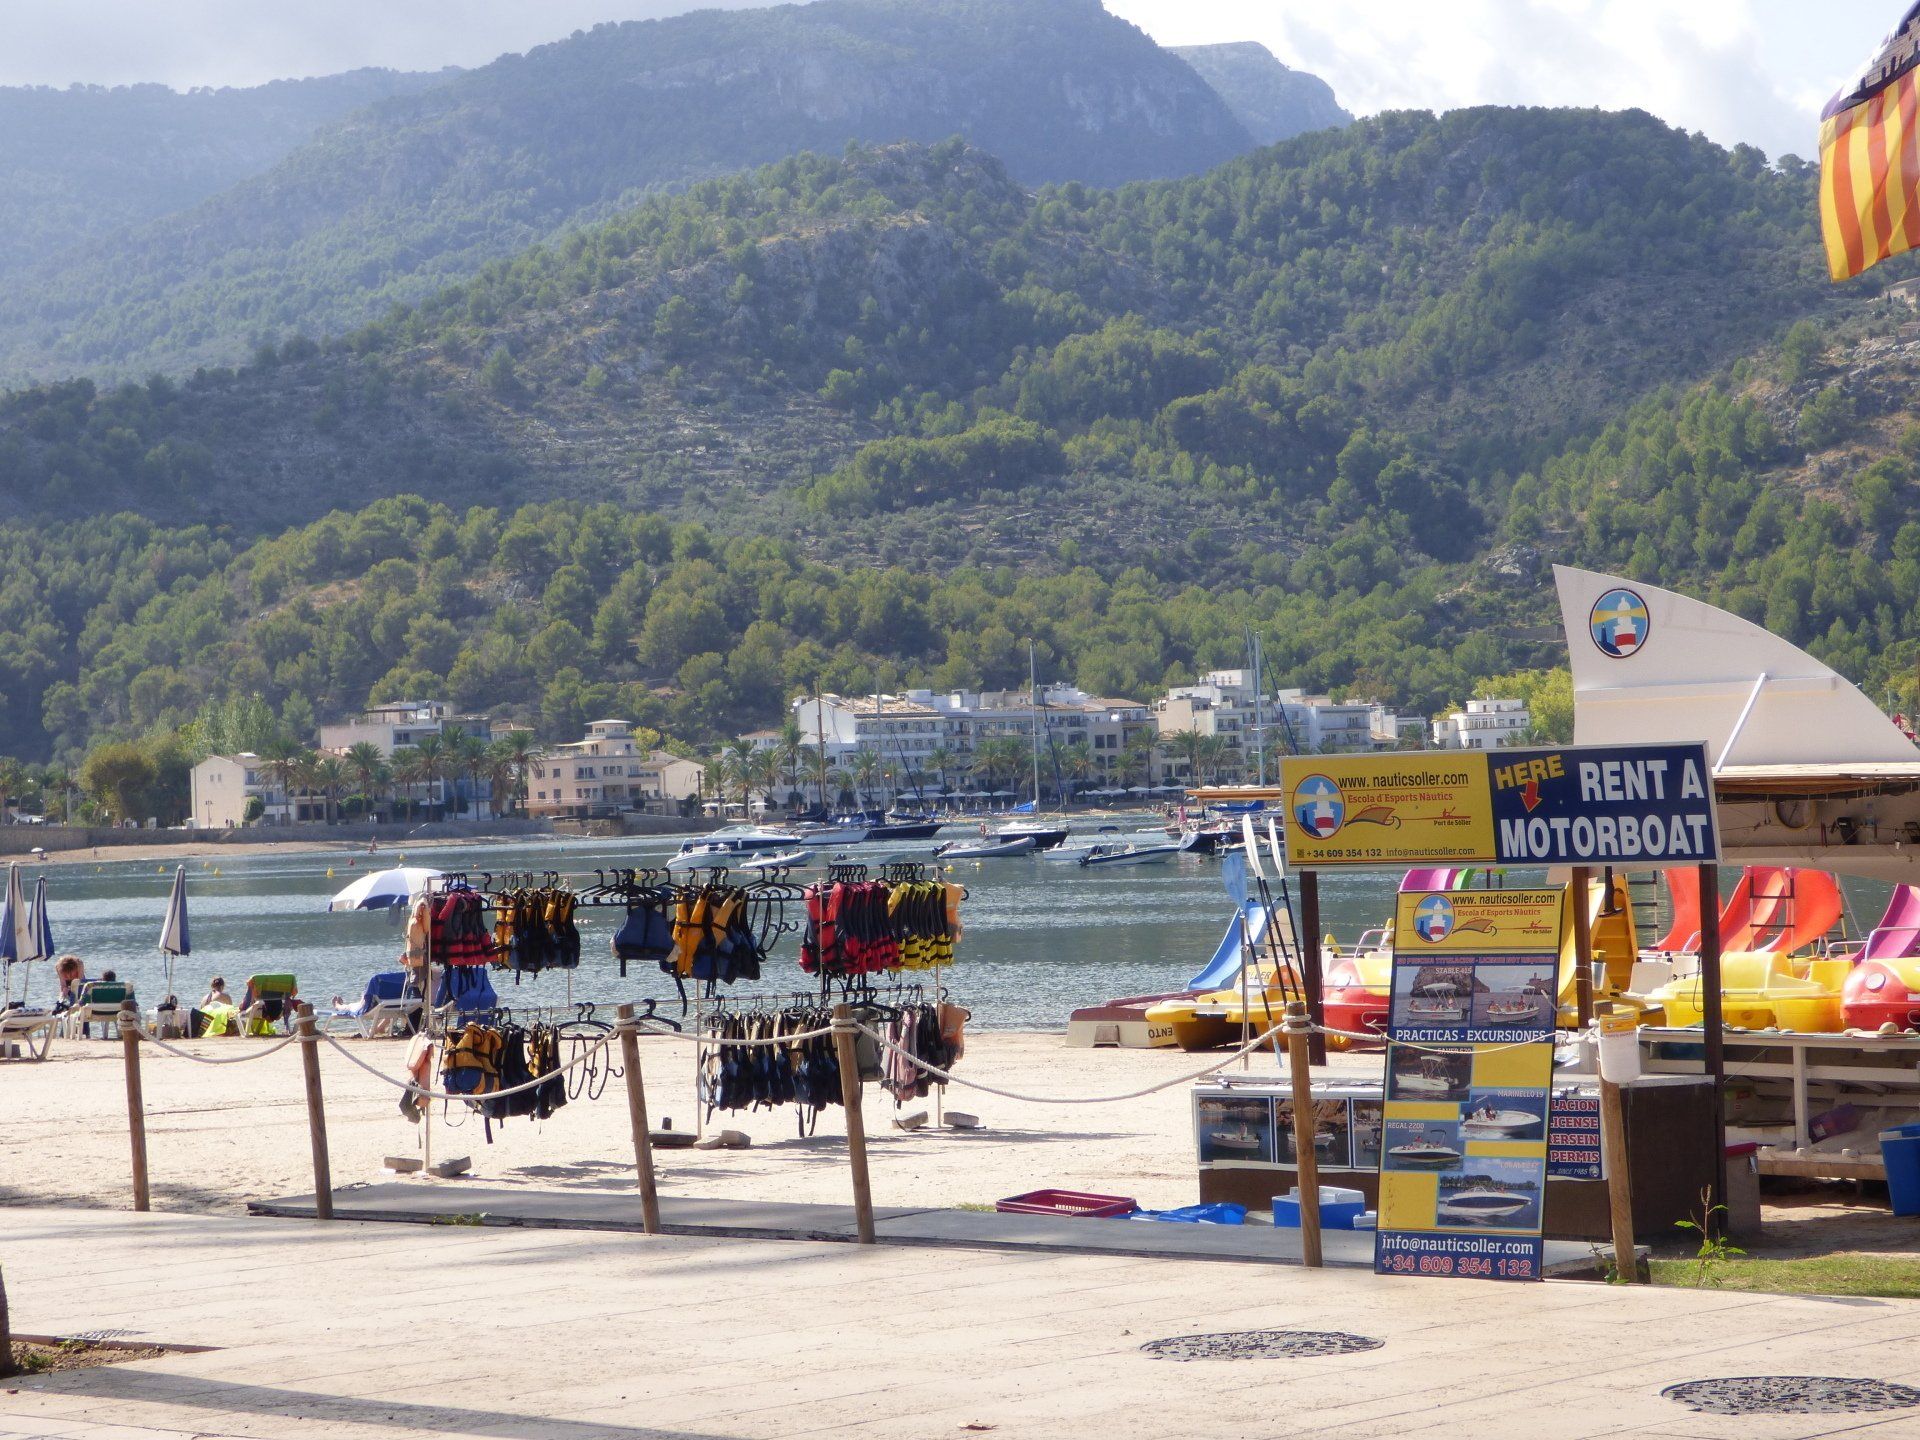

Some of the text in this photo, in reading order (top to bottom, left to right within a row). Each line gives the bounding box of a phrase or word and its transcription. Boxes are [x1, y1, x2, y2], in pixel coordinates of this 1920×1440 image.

[1495, 754, 1565, 790] HERE
[1339, 772, 1469, 788] www. nauticsoller.com
[1579, 758, 1704, 802] RENT A
[1348, 794, 1375, 803] Escola
[1500, 814, 1708, 858] MOTORBOAT
[1327, 850, 1343, 858] 609
[1453, 893, 1555, 905] www. nauticsoller.com
[1396, 1030, 1458, 1041] PRACTICAS
[1466, 1030, 1546, 1042] EXCURSIONES
[1536, 1090, 1544, 1098] 19
[1550, 1150, 1600, 1164] PERMIS
[1382, 1235, 1534, 1255] info@nauticsoller.com
[1383, 1254, 1532, 1277] +34 609 354 132
